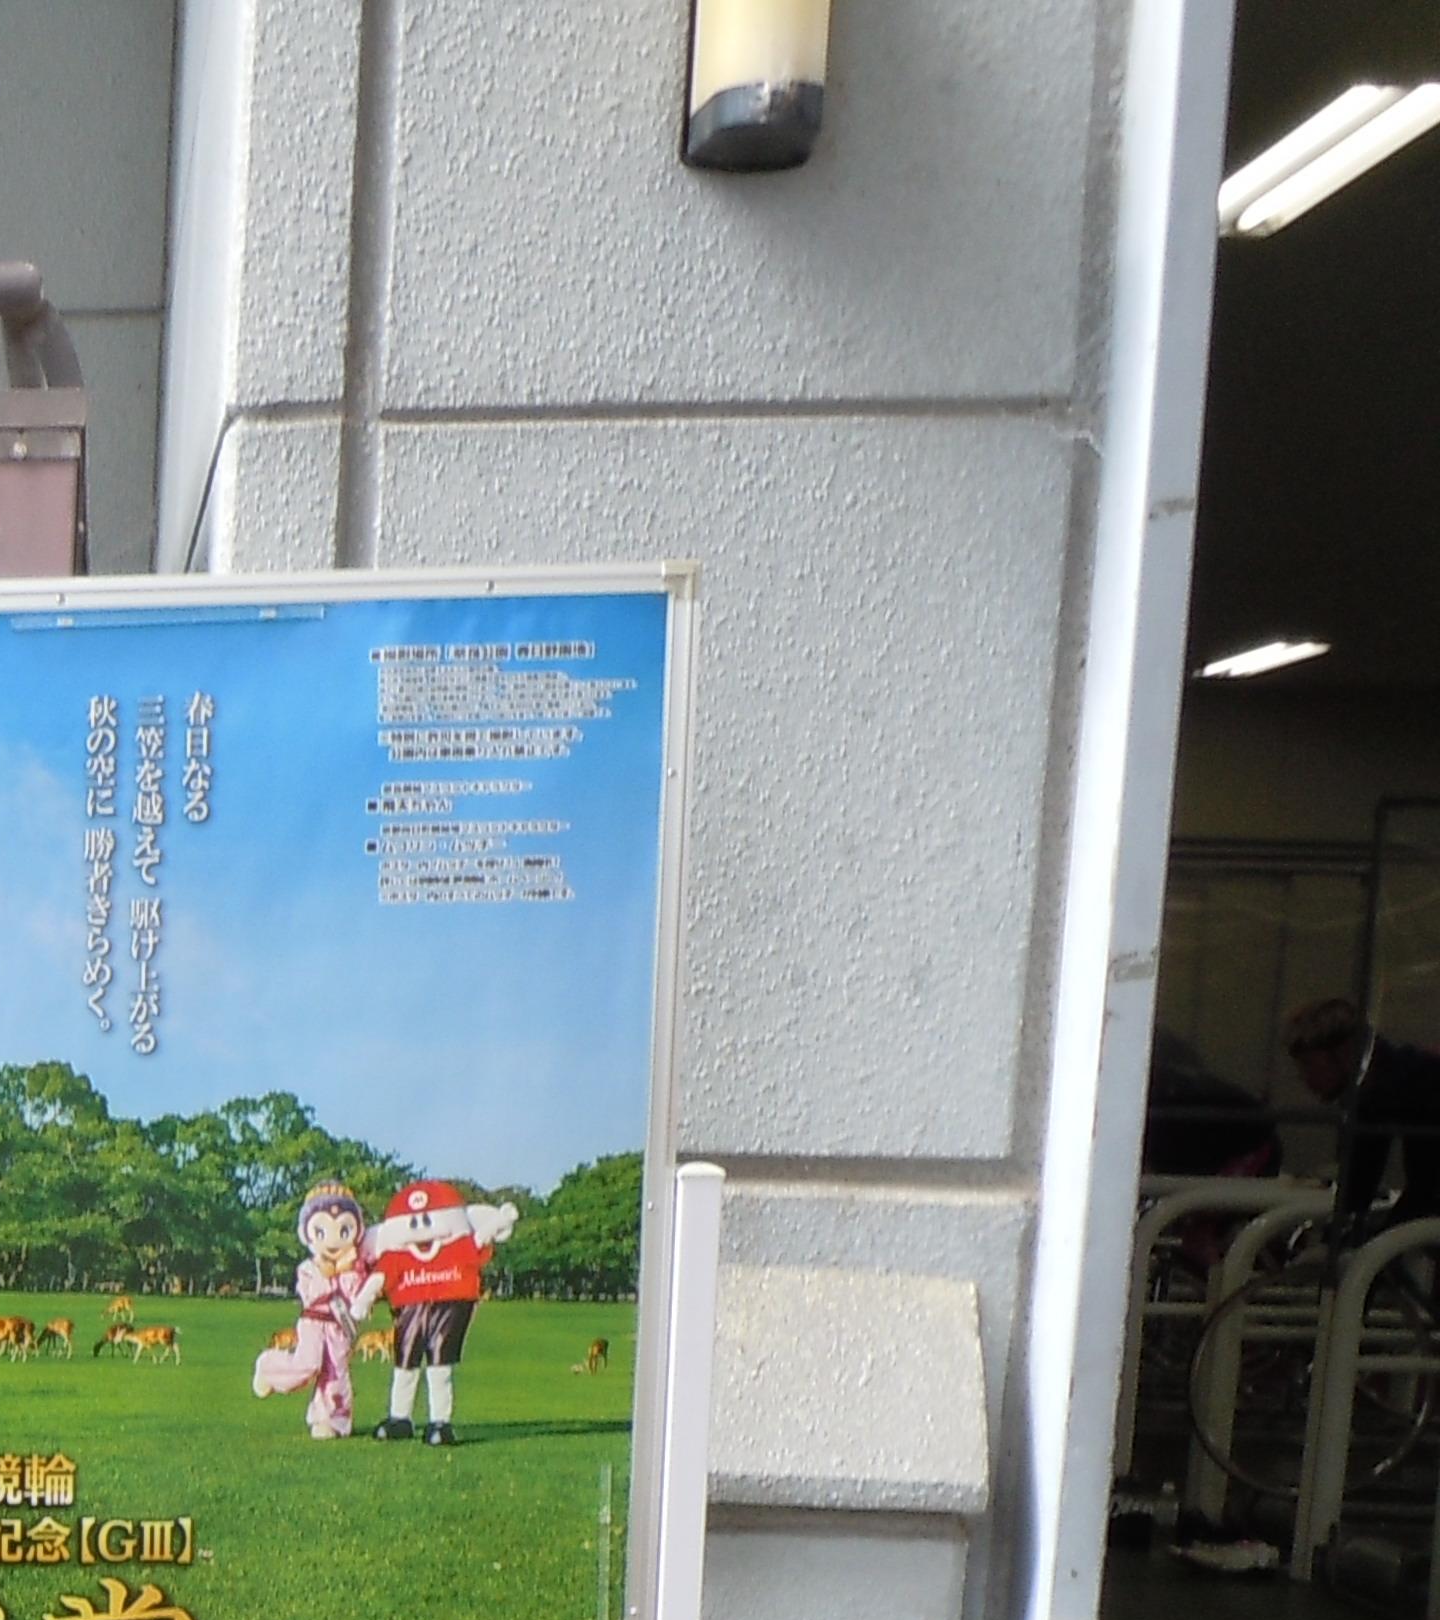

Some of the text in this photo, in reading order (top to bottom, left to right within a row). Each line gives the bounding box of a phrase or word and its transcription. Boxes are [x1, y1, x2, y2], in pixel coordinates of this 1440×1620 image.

[83, 695, 118, 1032] 秋の空に 勝者きらめく。
[129, 695, 165, 1054] 三笠を越えて 駆け上がる
[182, 691, 214, 822] 春日なる
